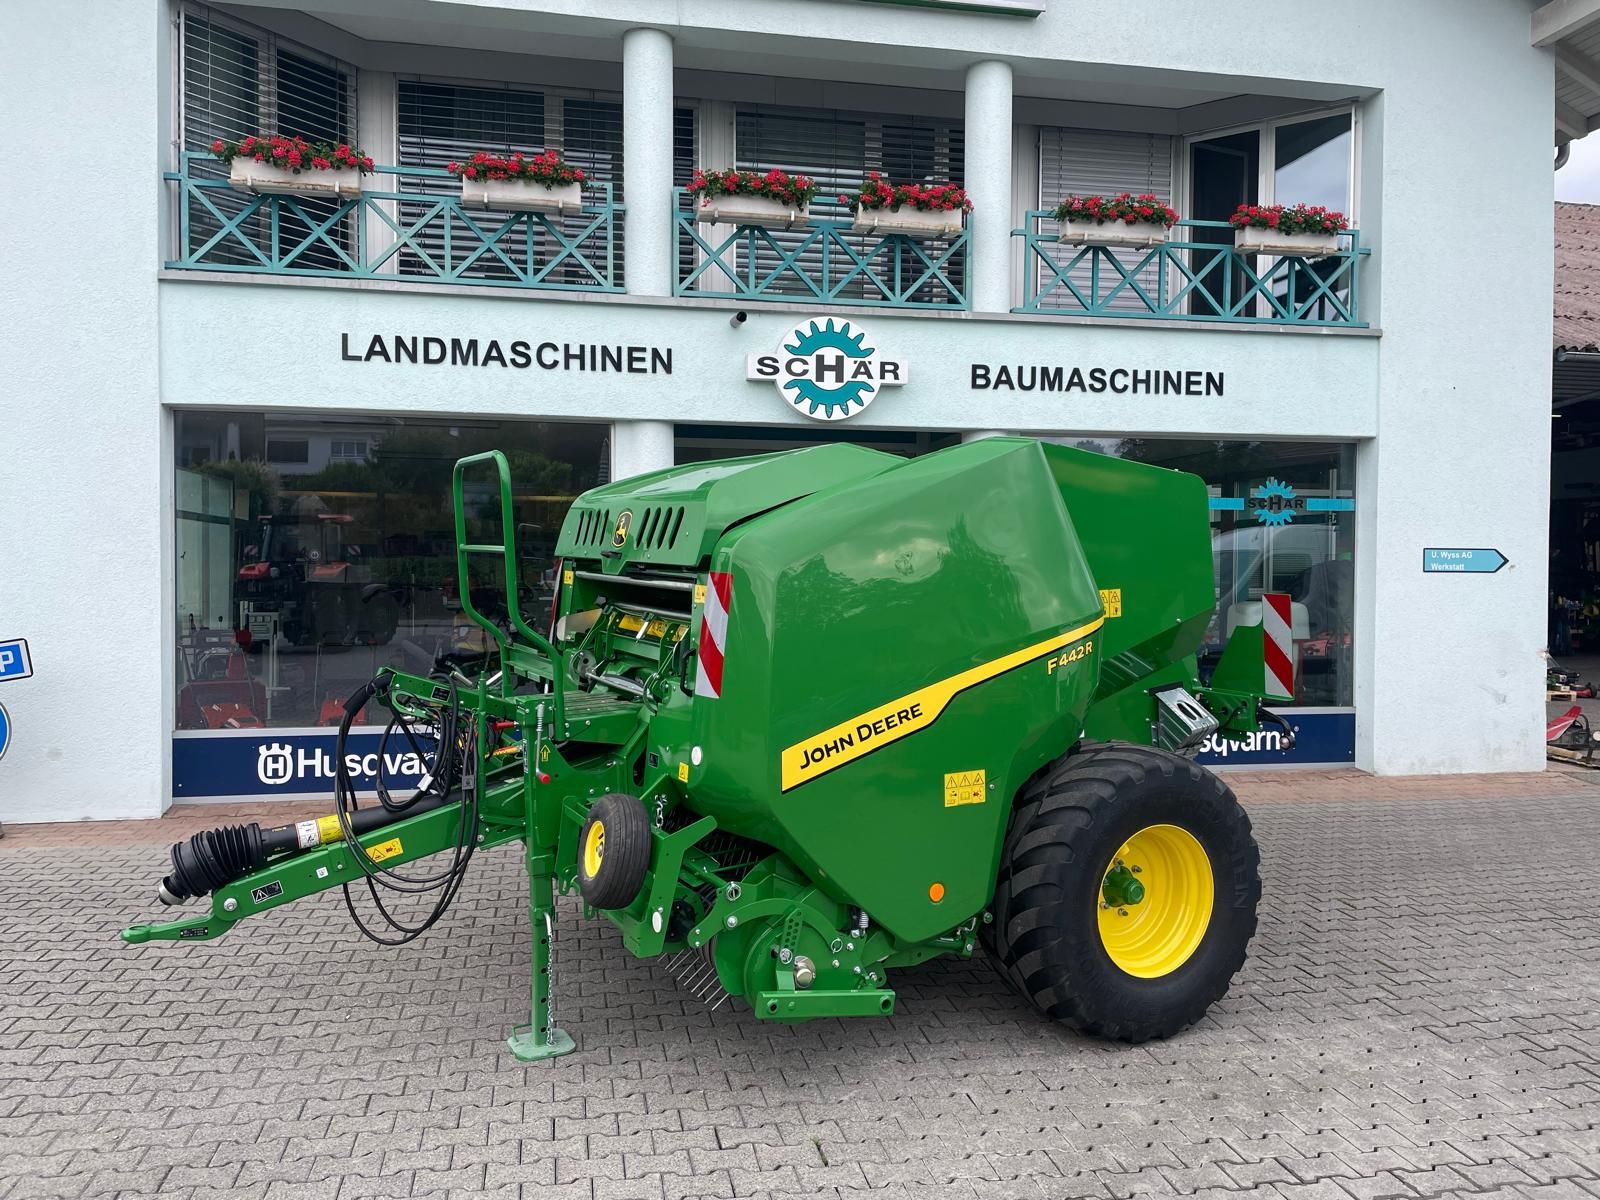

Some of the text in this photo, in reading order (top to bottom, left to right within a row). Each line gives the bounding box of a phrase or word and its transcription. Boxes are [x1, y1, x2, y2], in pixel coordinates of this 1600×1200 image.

[341, 333, 673, 375] LANDMASCHINEN
[756, 352, 900, 383] SCHÄR
[971, 364, 1225, 396] BAUMASCHINEN
[1431, 562, 1465, 570] Werkstatt
[1440, 551, 1460, 560] Wyss
[1461, 551, 1473, 559] AG
[0, 650, 14, 673] P
[800, 703, 923, 769] JOHN DEERE
